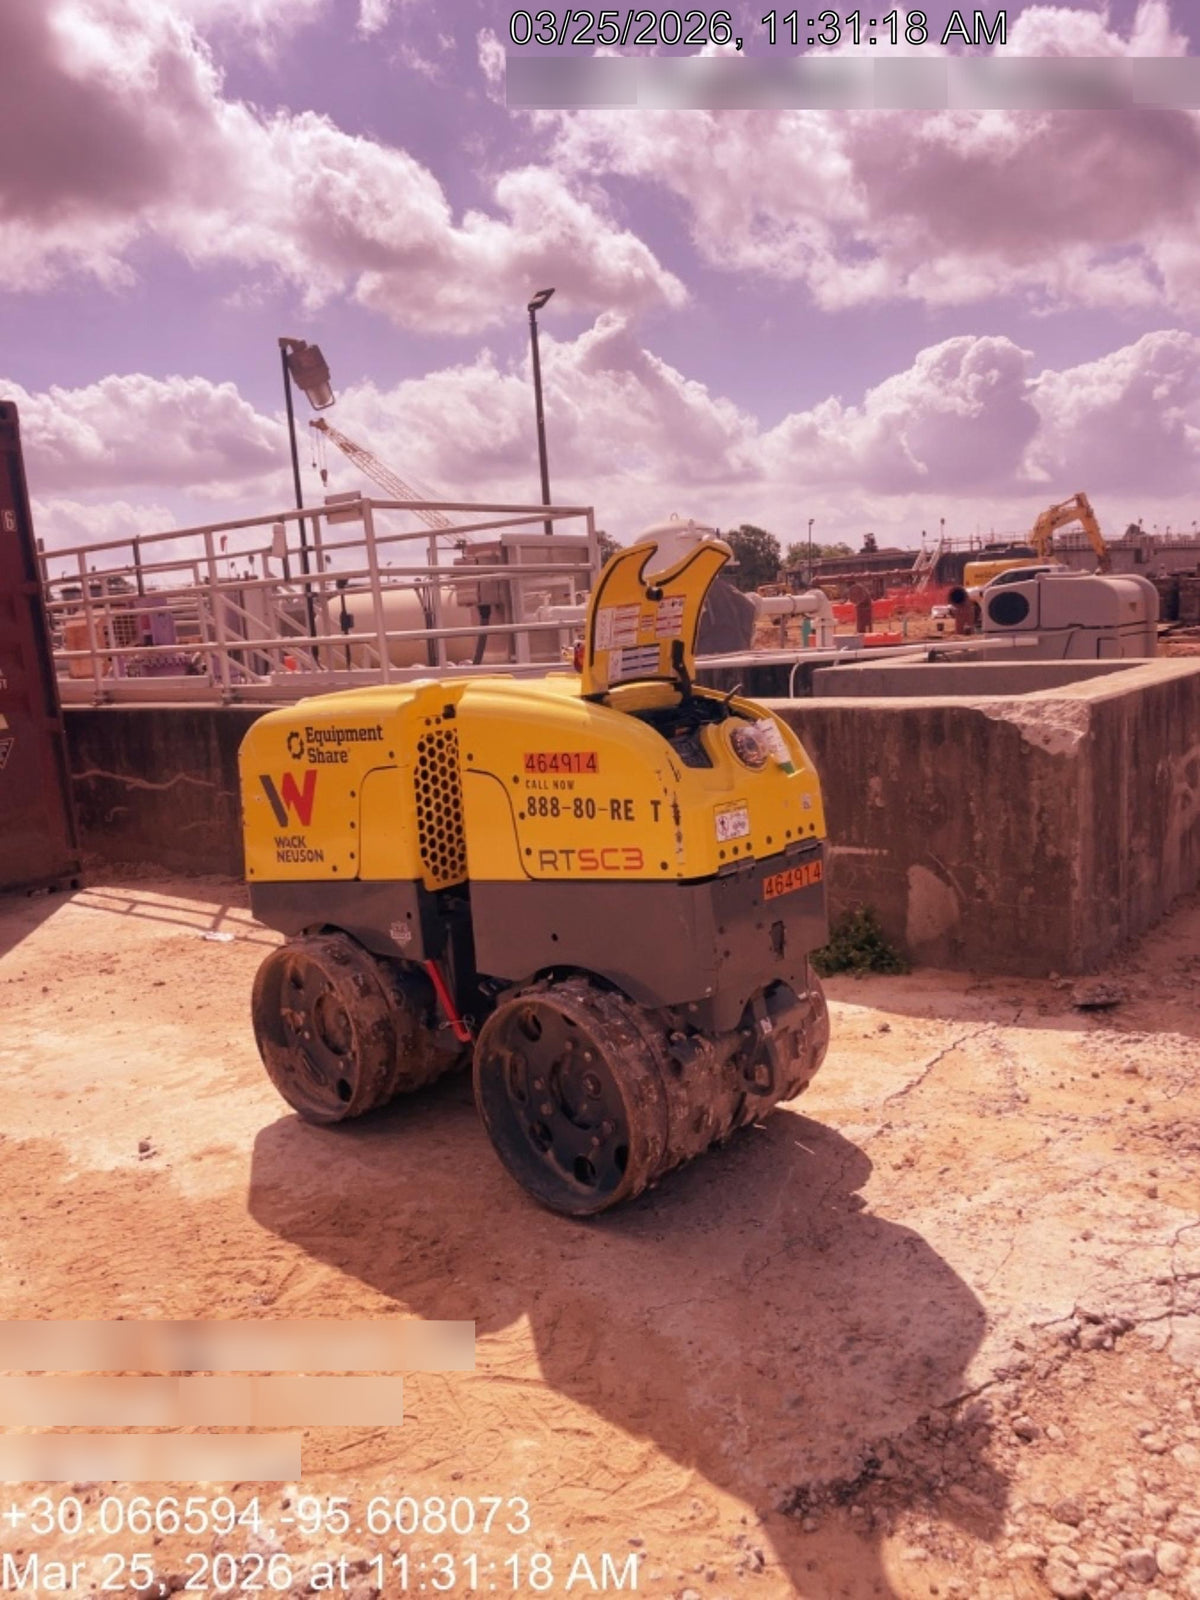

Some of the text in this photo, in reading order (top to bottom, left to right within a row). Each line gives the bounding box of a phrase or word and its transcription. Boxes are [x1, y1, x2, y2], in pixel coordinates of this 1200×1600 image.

[304, 725, 384, 746] Equipment
[307, 748, 348, 764] Share
[525, 753, 597, 773] 464914
[525, 780, 575, 790] CALL NOW
[277, 849, 324, 863] NEUSON
[539, 848, 644, 871] RTSC3
[766, 862, 821, 896] 464914
